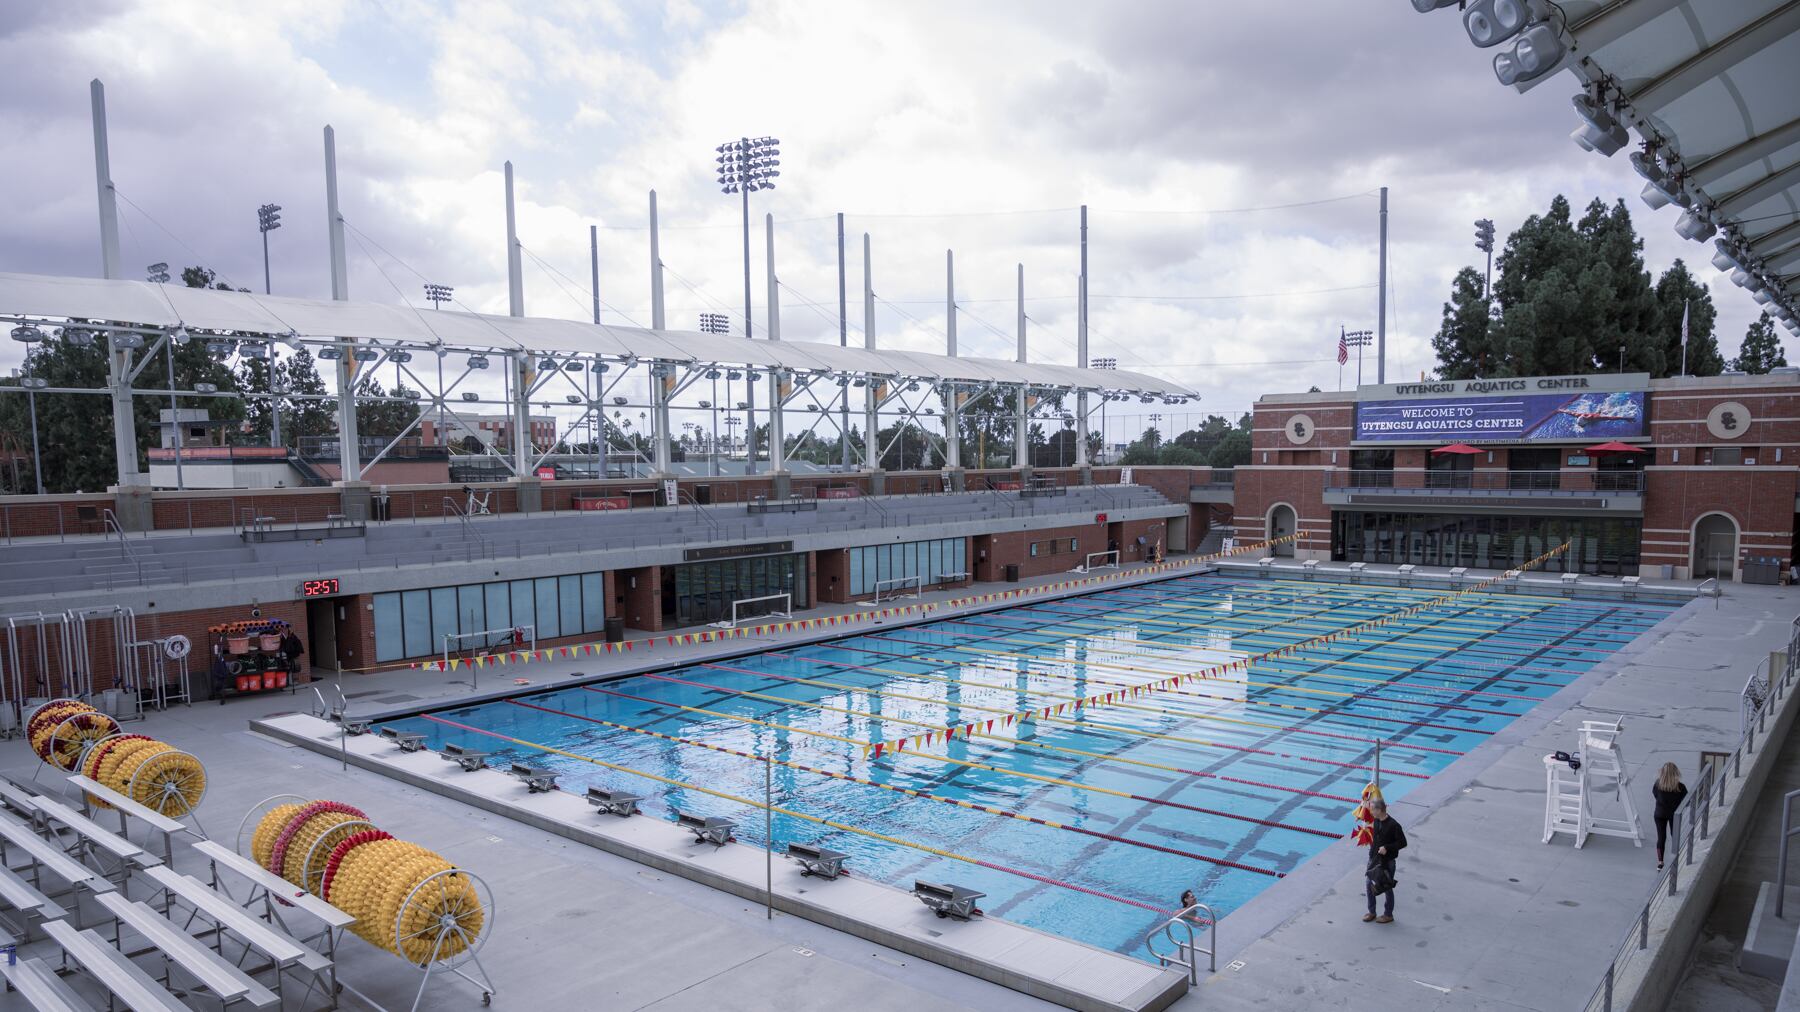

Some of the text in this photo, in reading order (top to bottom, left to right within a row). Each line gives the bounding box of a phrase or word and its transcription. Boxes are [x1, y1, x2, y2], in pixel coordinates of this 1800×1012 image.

[1396, 378, 1589, 394] UYTENGSU AQUATICS CENTER
[1402, 408, 1474, 418] WELCOME TO
[1361, 418, 1524, 430] UYTENGSU AQUATICS CENTER
[304, 580, 338, 596] 52:57
